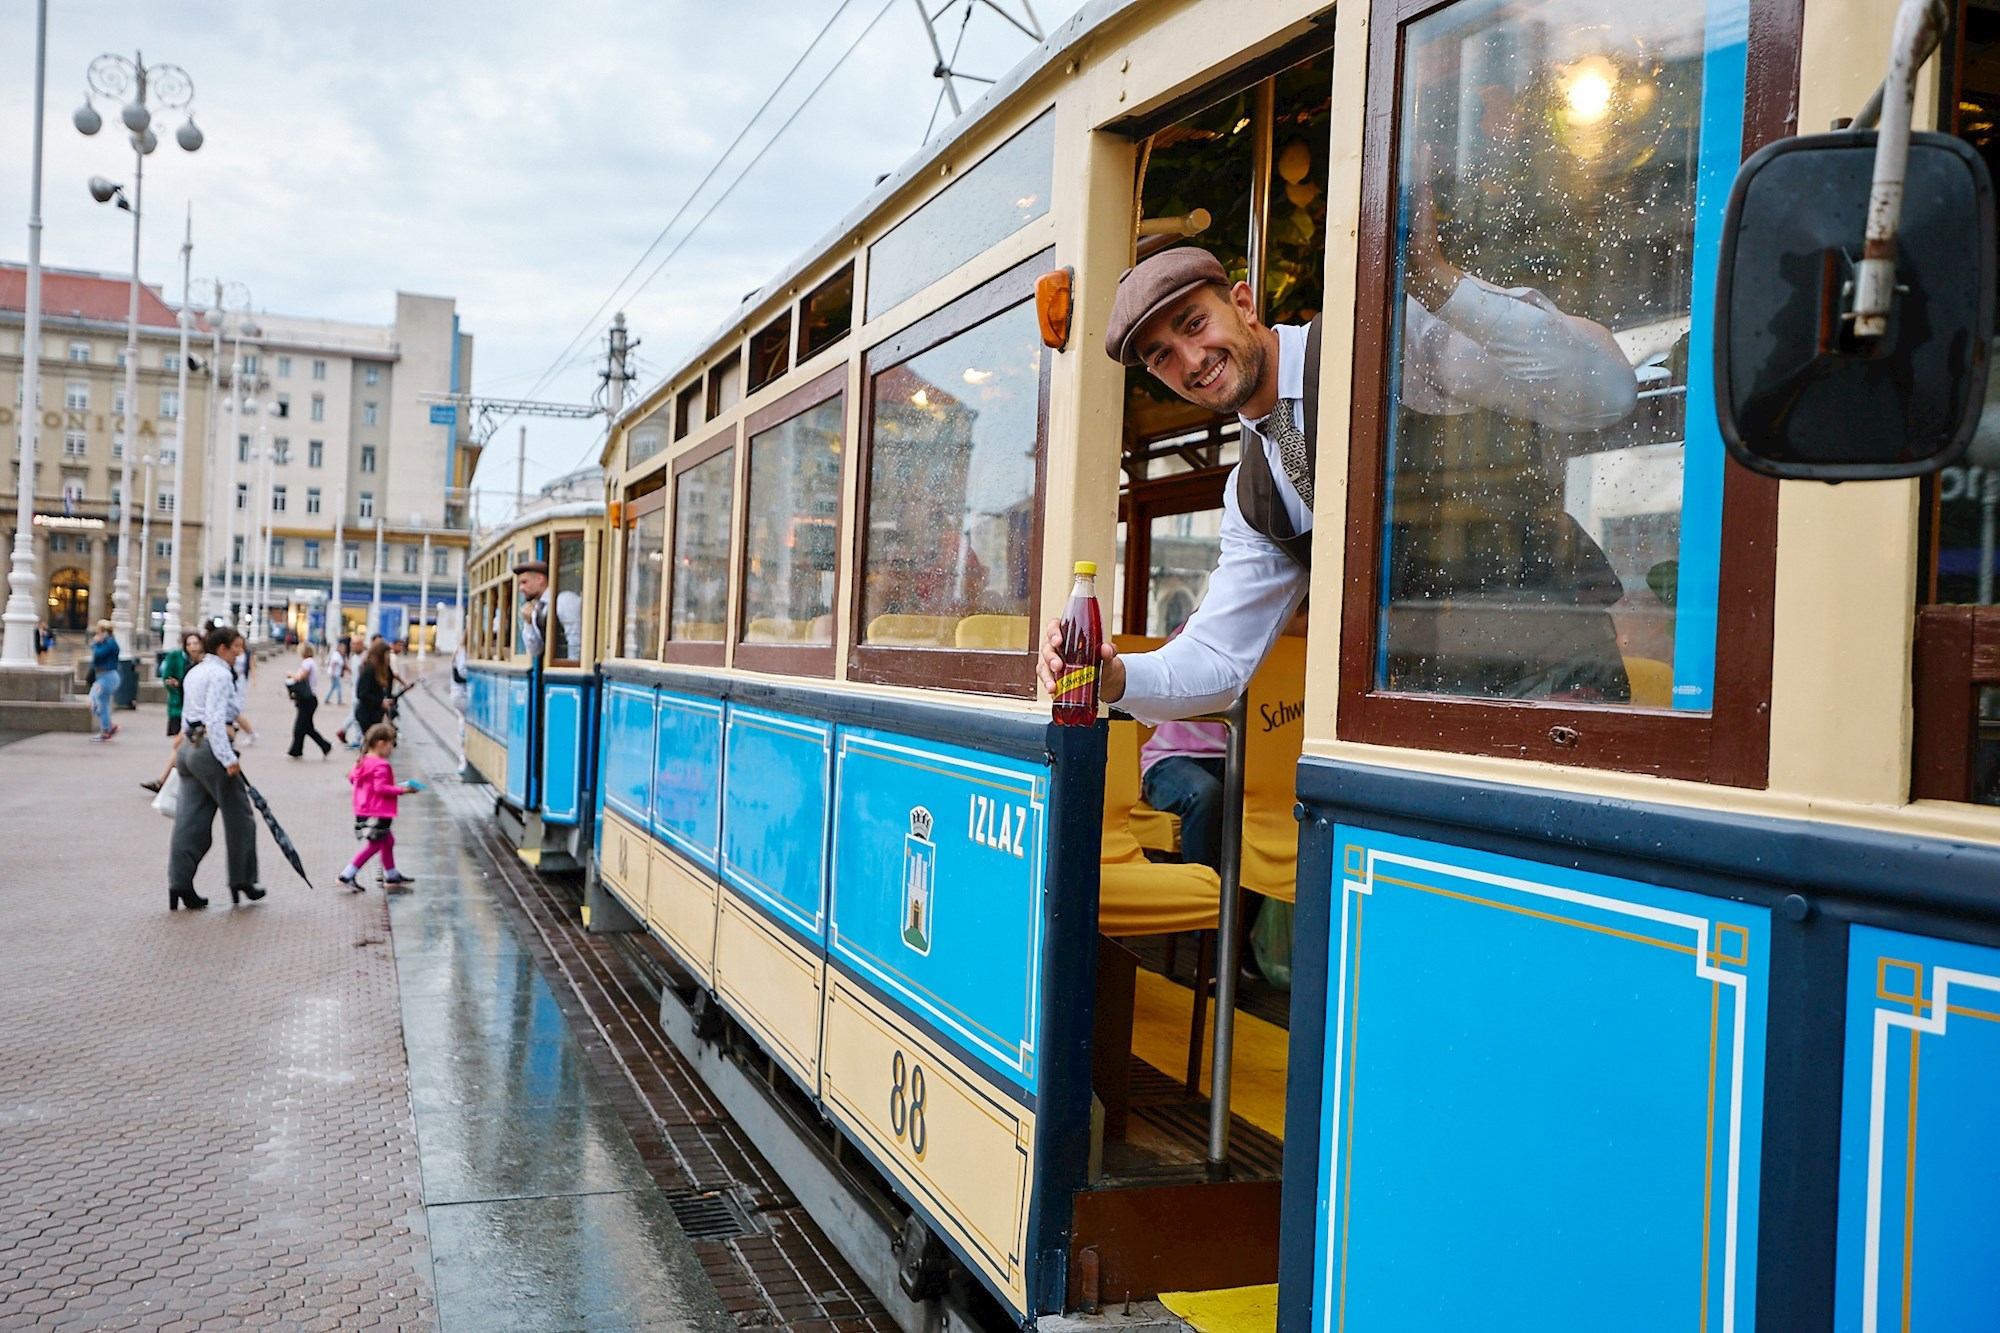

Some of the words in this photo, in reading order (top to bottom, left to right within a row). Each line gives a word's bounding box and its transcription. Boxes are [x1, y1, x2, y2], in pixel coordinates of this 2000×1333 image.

[1260, 700, 1304, 732] Schw
[968, 793, 1026, 858] IZLAZ
[890, 1049, 928, 1163] 88
